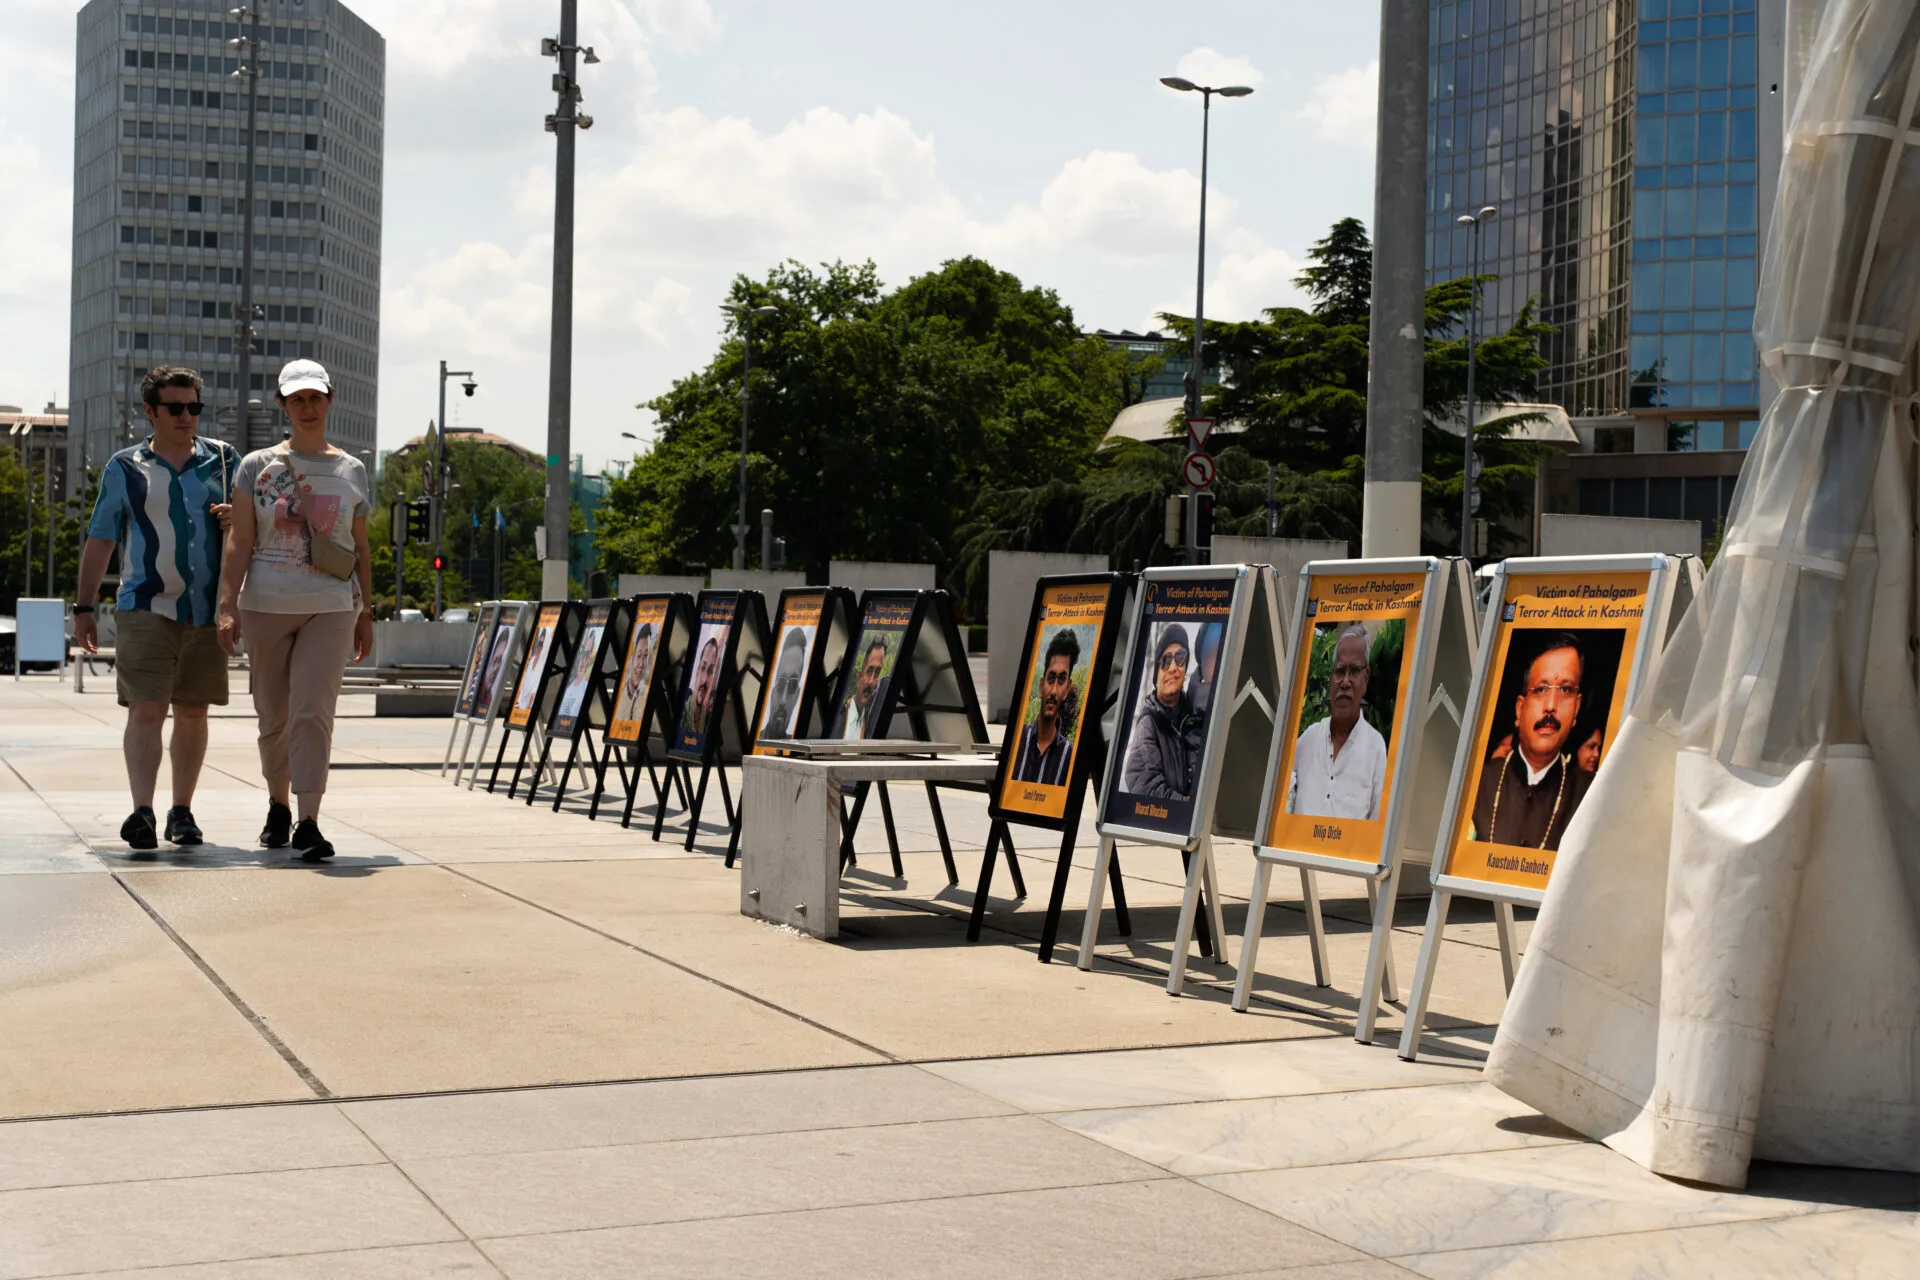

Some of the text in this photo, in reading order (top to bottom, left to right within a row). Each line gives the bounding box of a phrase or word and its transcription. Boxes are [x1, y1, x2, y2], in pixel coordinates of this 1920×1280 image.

[1166, 586, 1229, 601] Victim of Pahalgam
[1333, 580, 1414, 595] Victim of Pahalgam
[1536, 584, 1637, 601] Victim of Pahalgam
[1155, 604, 1175, 614] Terror
[1176, 604, 1197, 614] Attack
[1199, 604, 1205, 614] in
[1320, 597, 1422, 613] Terror Attack in Kashmir
[1519, 605, 1549, 618] Terror
[1552, 605, 1584, 618] Attack
[1588, 604, 1598, 617] in
[1486, 852, 1549, 876] Kaustubh Ganbote
